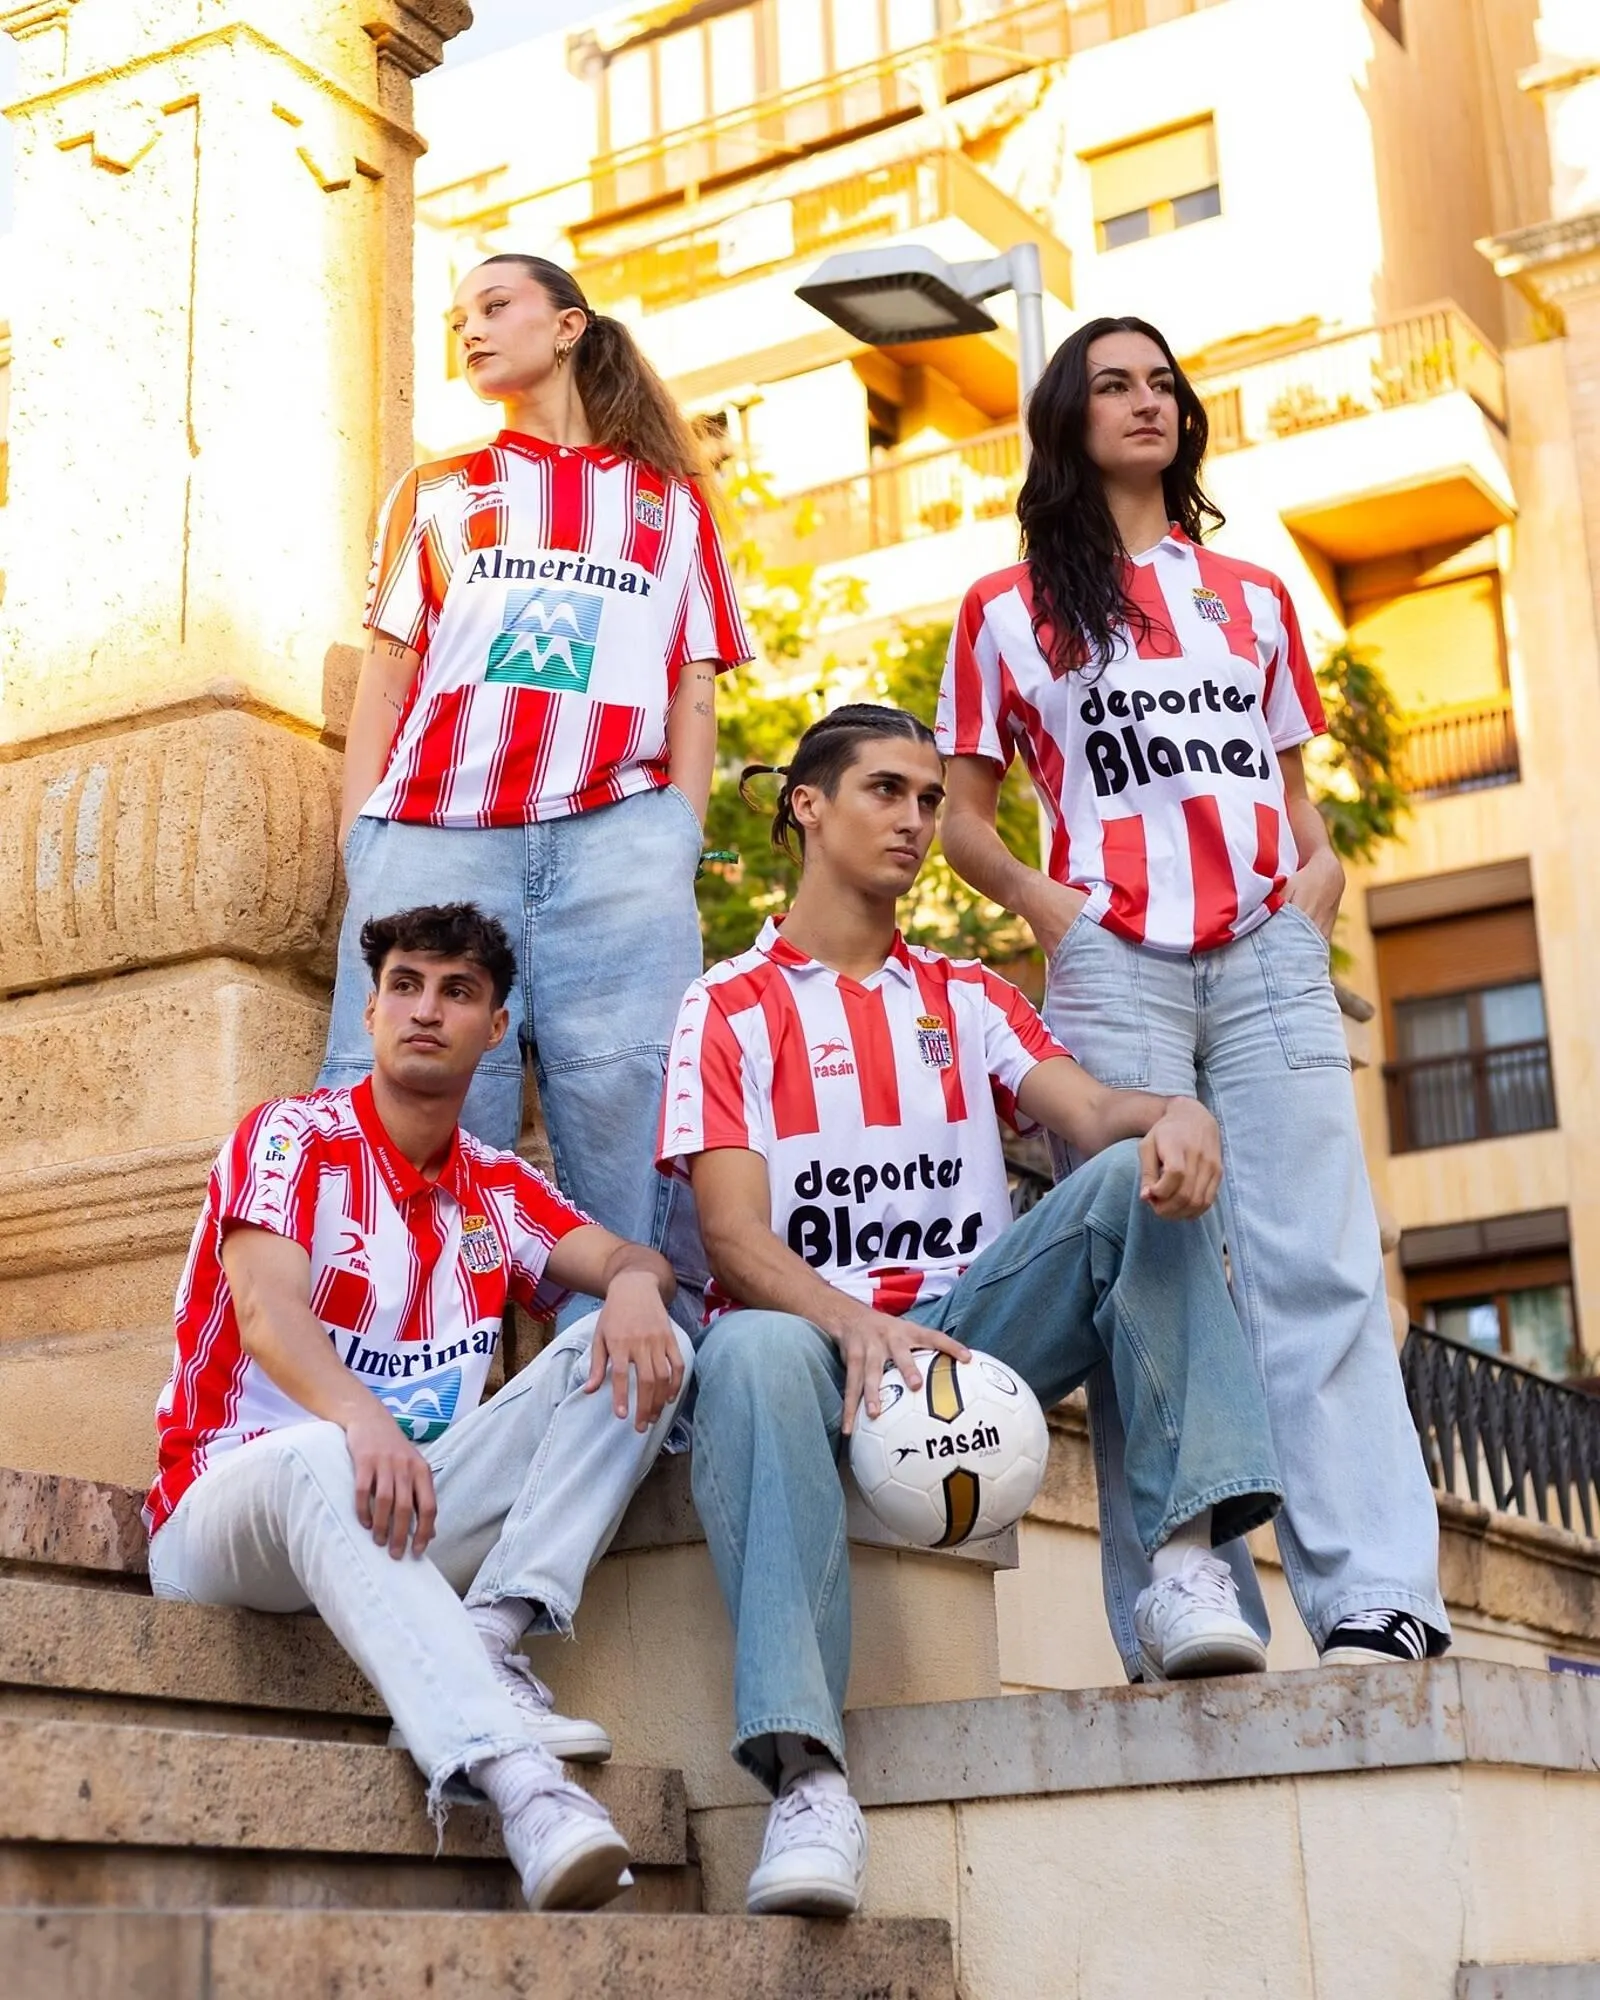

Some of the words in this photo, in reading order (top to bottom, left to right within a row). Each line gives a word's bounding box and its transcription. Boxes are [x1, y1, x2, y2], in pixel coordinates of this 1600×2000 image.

[466, 549, 651, 597] Almerimar
[814, 1059, 854, 1078] rasán
[794, 1153, 963, 1204] deportes
[787, 1204, 983, 1270] Blanes
[926, 1420, 1000, 1460] rasán
